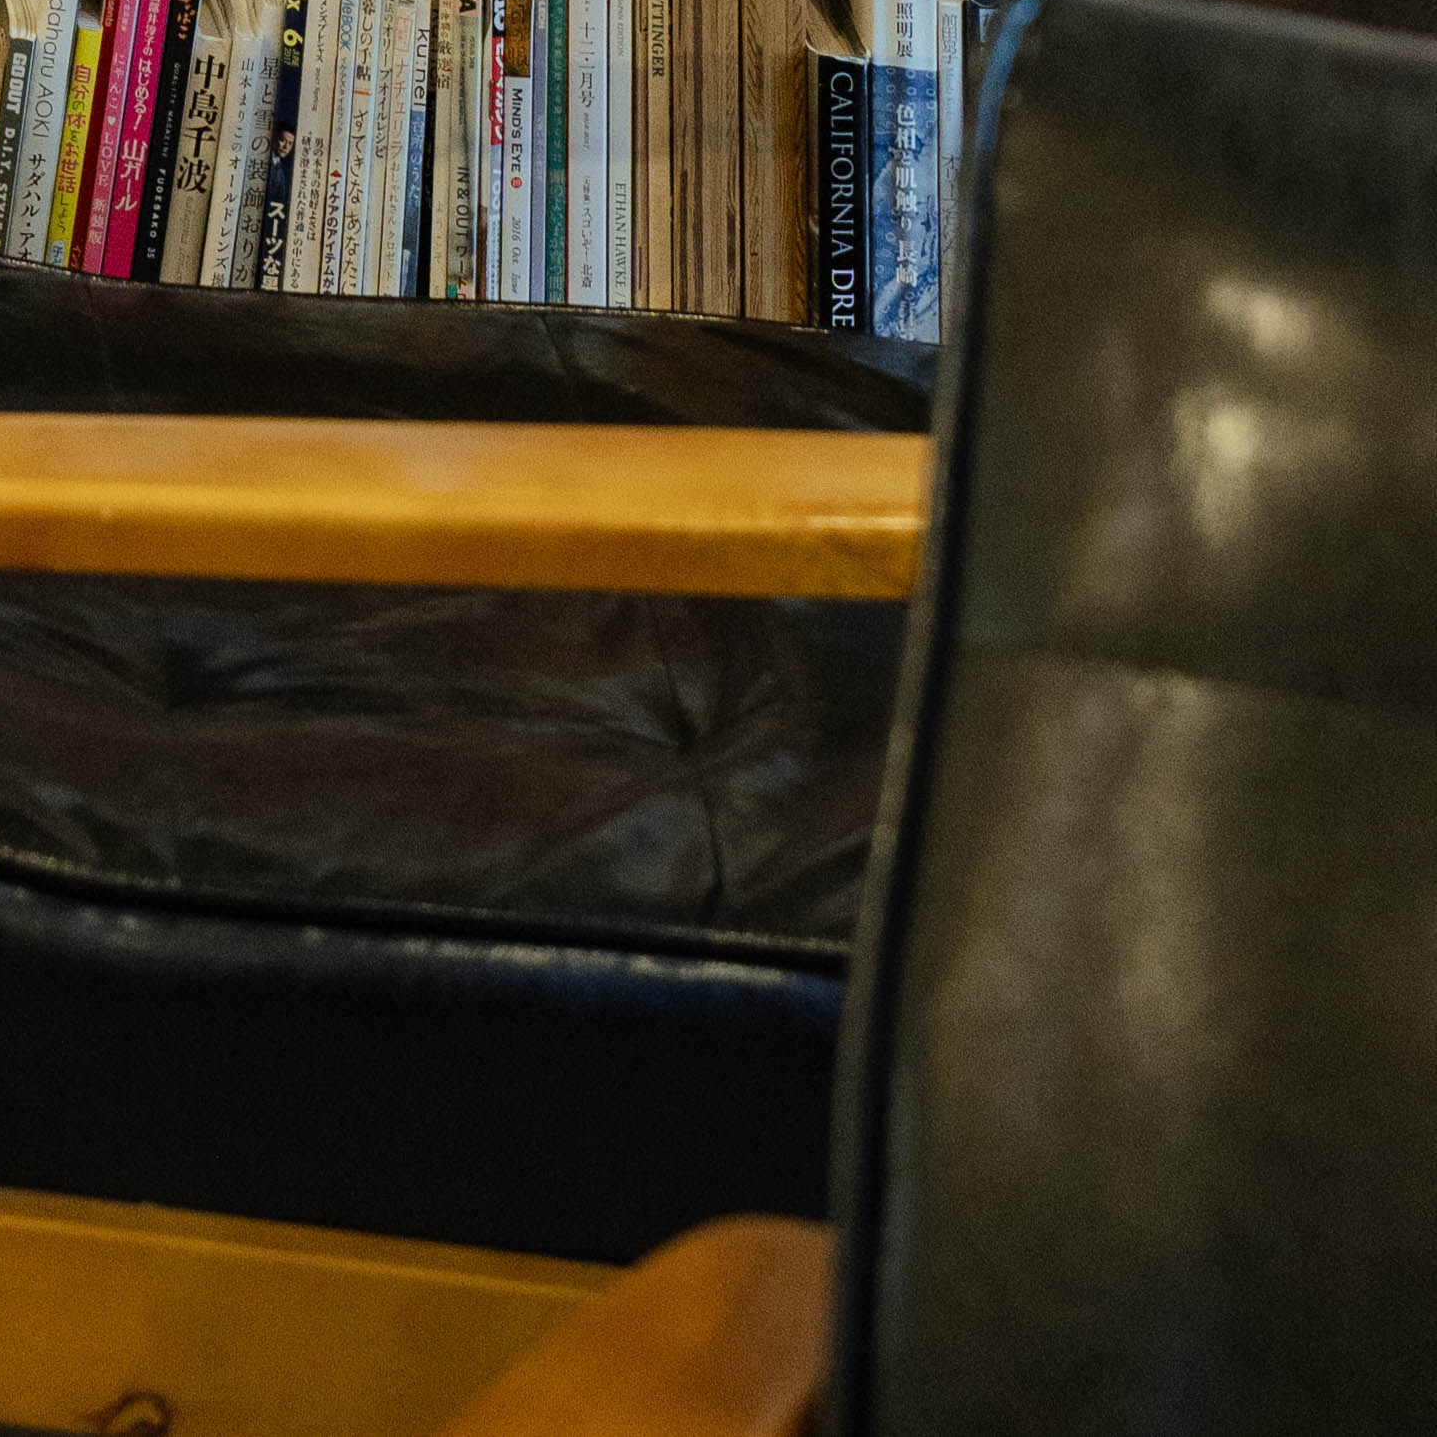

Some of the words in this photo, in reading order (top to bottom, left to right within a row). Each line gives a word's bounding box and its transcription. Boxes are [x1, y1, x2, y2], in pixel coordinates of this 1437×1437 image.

[32, 86, 54, 137] AOKI
[177, 54, 226, 194] 中島千波
[511, 88, 523, 139] MIND'S
[511, 144, 522, 173] EYE
[829, 71, 855, 258] CALIFORNIA
[614, 183, 626, 234] ETHAN
[614, 239, 626, 289] HAWKE
